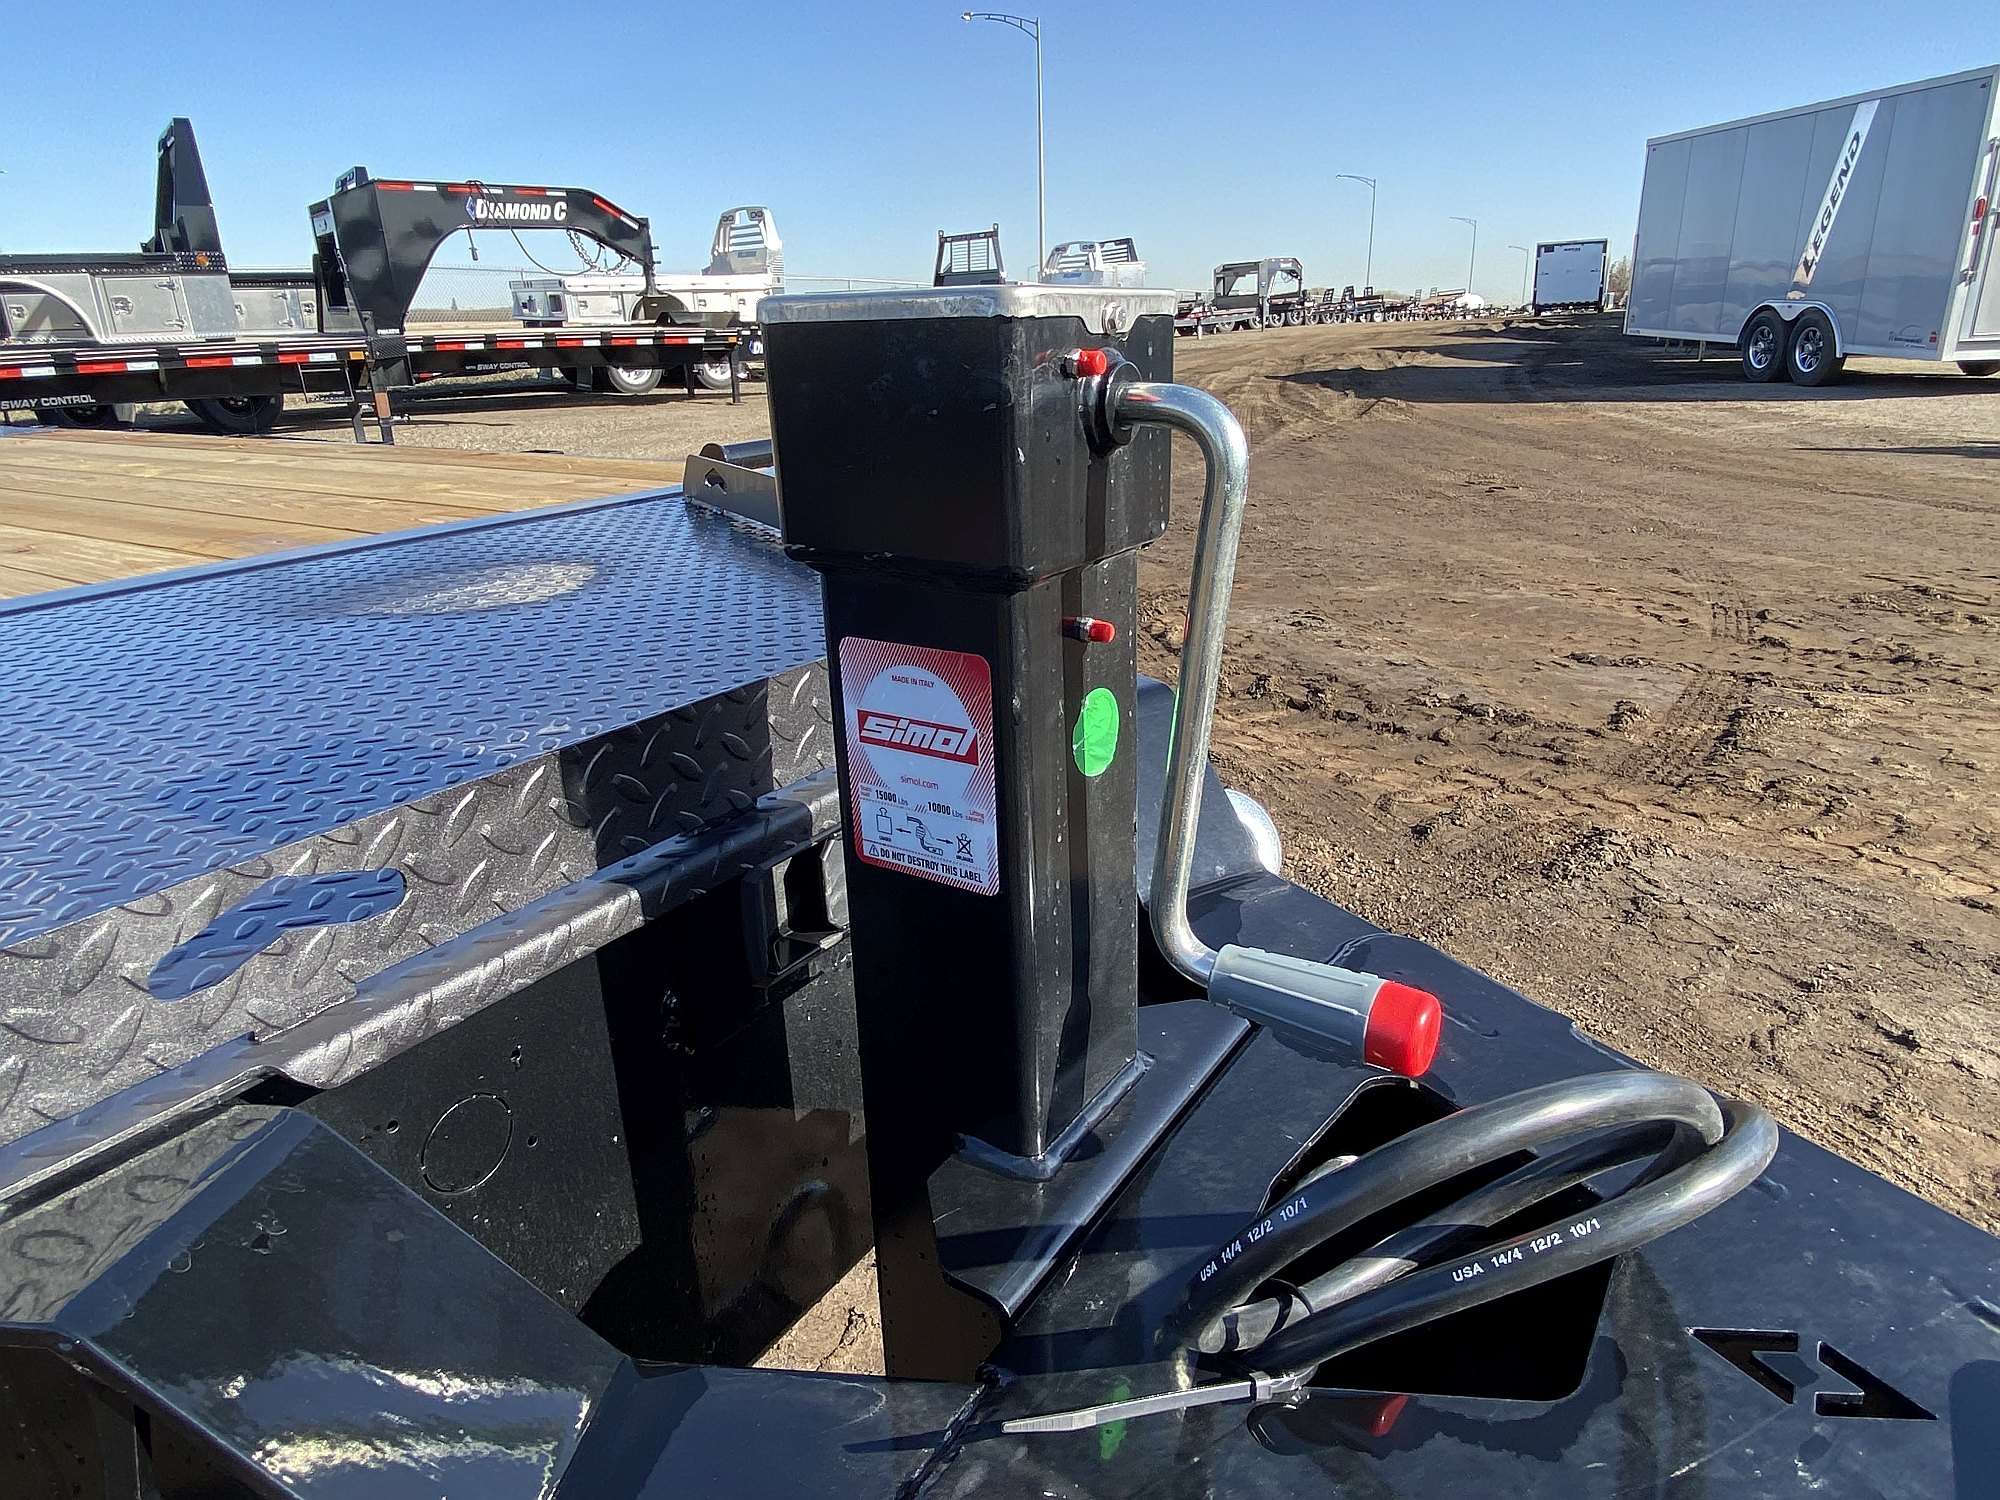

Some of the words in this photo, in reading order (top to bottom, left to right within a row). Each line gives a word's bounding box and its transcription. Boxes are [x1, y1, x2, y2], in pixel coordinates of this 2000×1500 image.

[475, 198, 552, 221] DIAMOND
[554, 201, 567, 221] C
[1803, 131, 1861, 277] LEGEND
[477, 363, 498, 371] SWAY
[499, 361, 531, 369] CONTROL
[1, 399, 38, 410] SWAY
[41, 395, 96, 407] CONTROL
[891, 675, 910, 685] MADE
[910, 678, 918, 686] IN
[918, 679, 935, 689] ITALY
[900, 776, 939, 790] simol.com
[875, 789, 897, 803] 15000
[928, 801, 951, 816] 10000
[880, 847, 890, 859] DO
[891, 850, 906, 863] NOT
[907, 854, 939, 872] DESTROY
[940, 863, 958, 877] THIS
[959, 868, 983, 883] LABEL
[1200, 1261, 1218, 1282] USA
[1221, 1240, 1242, 1264] 14/4
[1247, 1219, 1274, 1243] 12/2
[1279, 1197, 1308, 1221] 10/1
[1452, 1262, 1484, 1282] USA
[1491, 1247, 1523, 1268] 14/4
[1529, 1232, 1563, 1253] 12/2
[1569, 1217, 1601, 1238] 10/1
